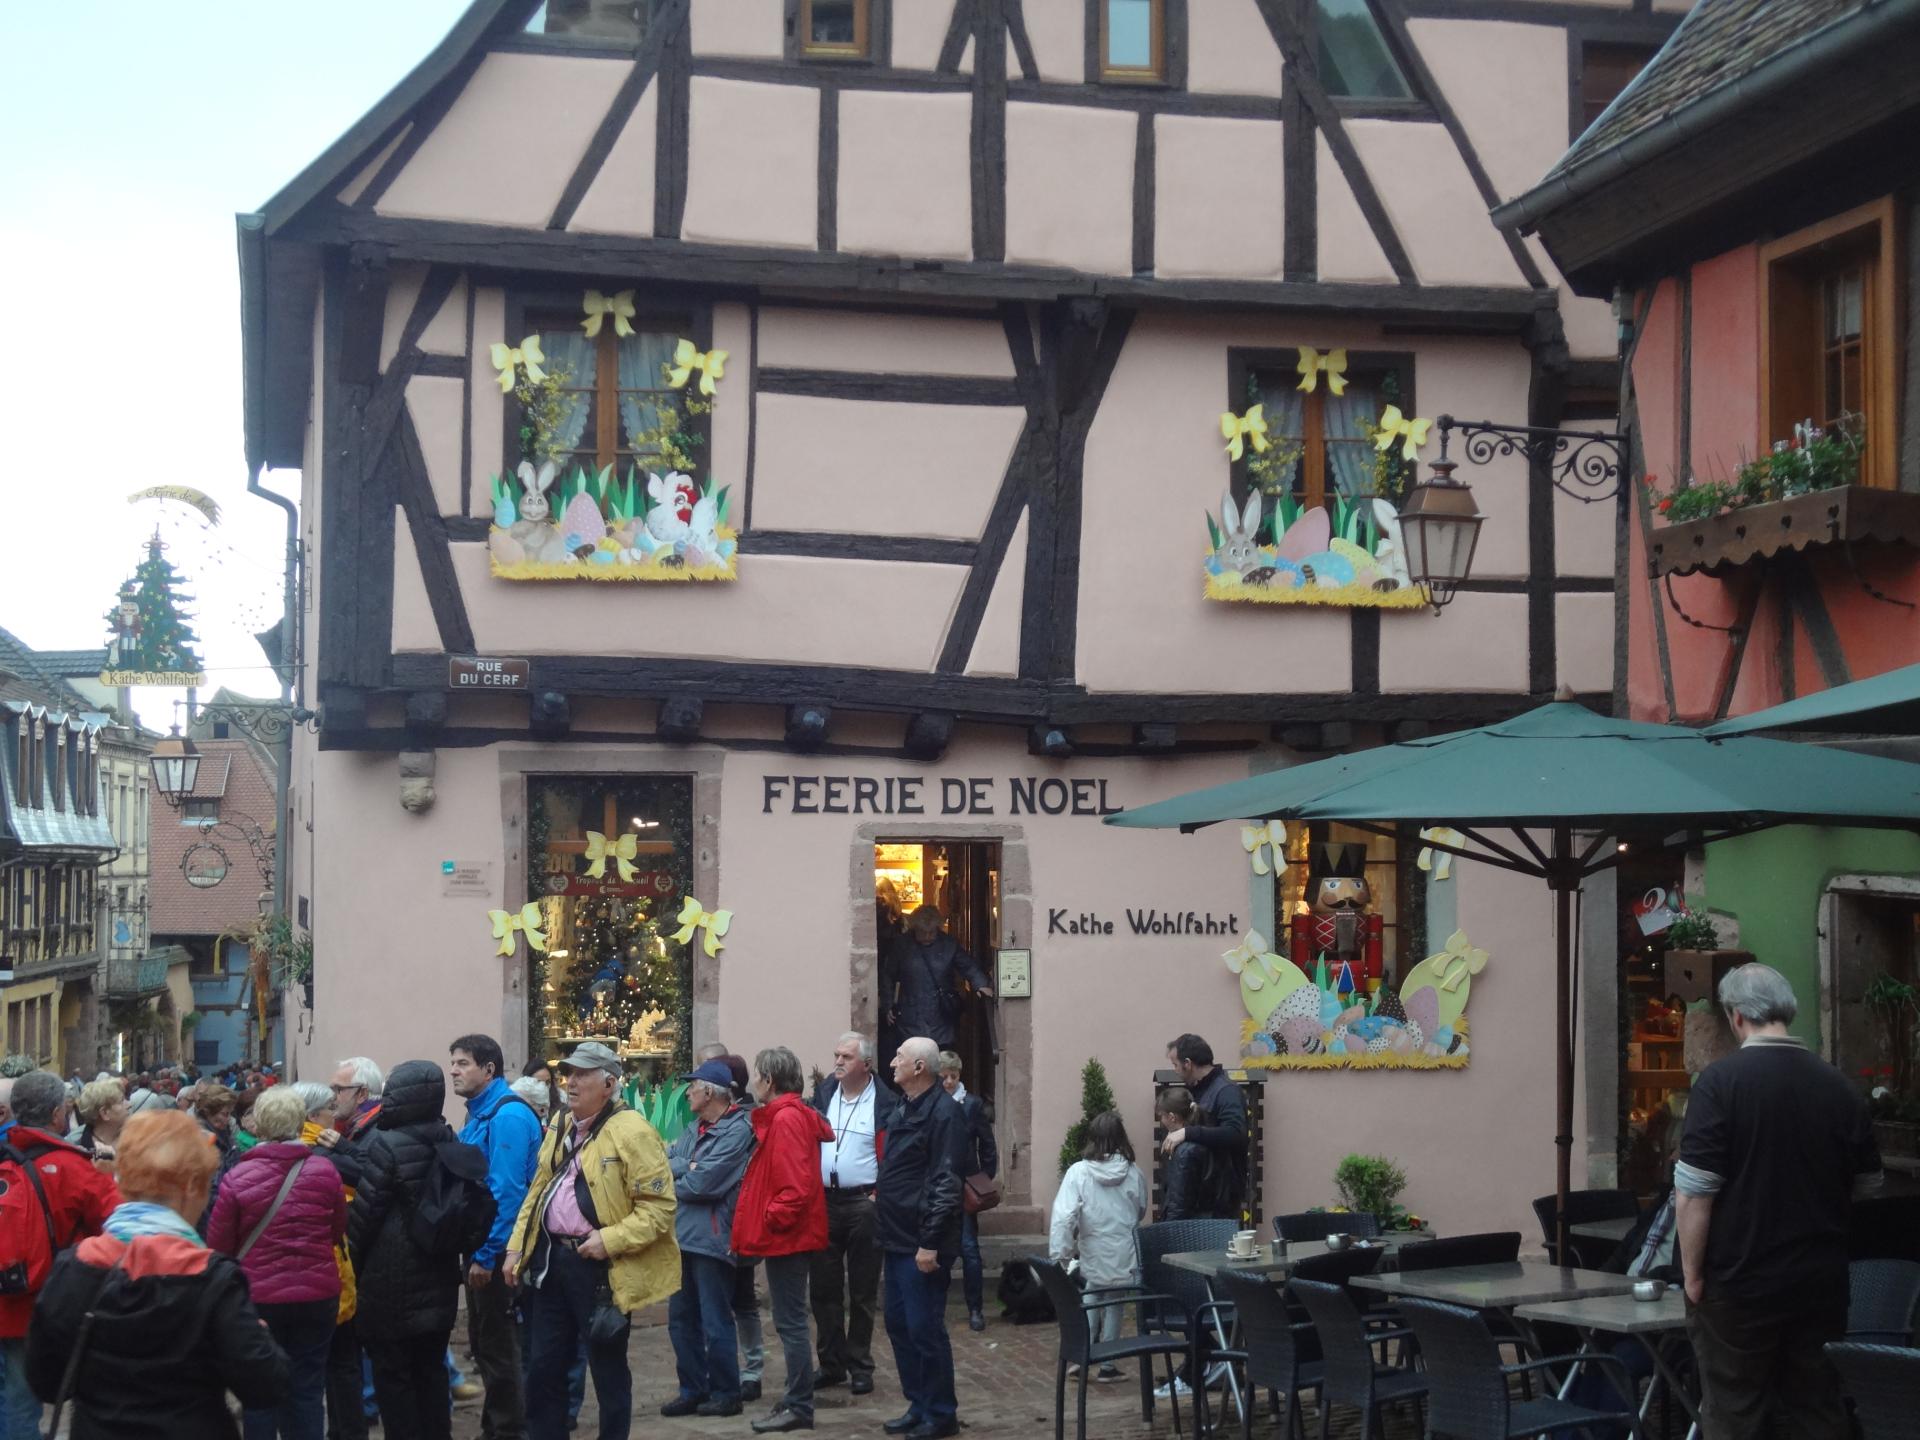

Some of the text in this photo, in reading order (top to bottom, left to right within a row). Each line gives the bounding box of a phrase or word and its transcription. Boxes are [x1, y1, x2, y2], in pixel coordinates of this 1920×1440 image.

[476, 662, 503, 672] RUE
[108, 671, 200, 686] Käthe Wohlfahrt
[460, 673, 520, 685] DU CERF
[762, 775, 1125, 815] FEERIE DE NOEL
[1126, 909, 1239, 935] Wohlfahrt
